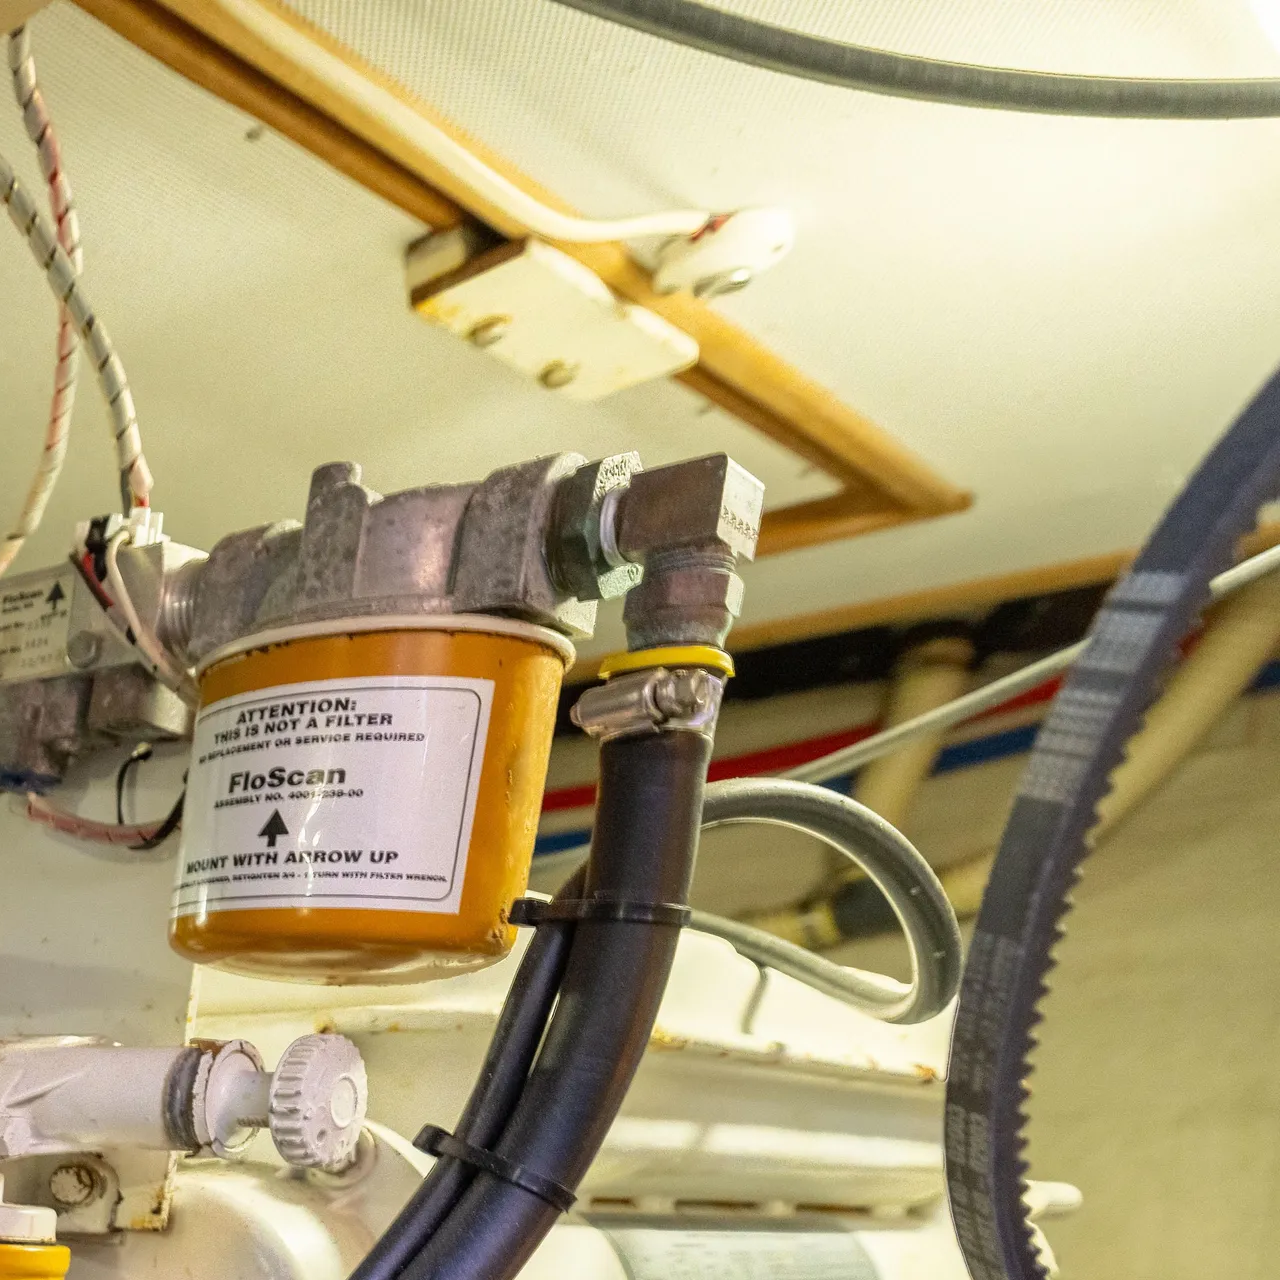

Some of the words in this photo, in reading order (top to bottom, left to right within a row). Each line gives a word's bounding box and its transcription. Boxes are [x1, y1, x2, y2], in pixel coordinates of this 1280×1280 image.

[236, 697, 357, 724] ATTENTION:
[214, 727, 241, 745] THIS
[244, 723, 260, 737] IS
[264, 717, 300, 734] NOT
[306, 715, 319, 730] A
[326, 713, 393, 728] FILTER
[295, 733, 351, 746] SERVICE
[354, 732, 425, 743] REQUIRED
[228, 766, 346, 794] FloScan
[214, 795, 262, 809] ASSEMBLY
[265, 791, 284, 801] NO.
[186, 854, 229, 874] MOUNT
[233, 852, 278, 867] WITH
[284, 850, 363, 865] ARROW
[369, 851, 399, 865] UP
[341, 871, 367, 879] WITH
[369, 872, 403, 881] FILTER
